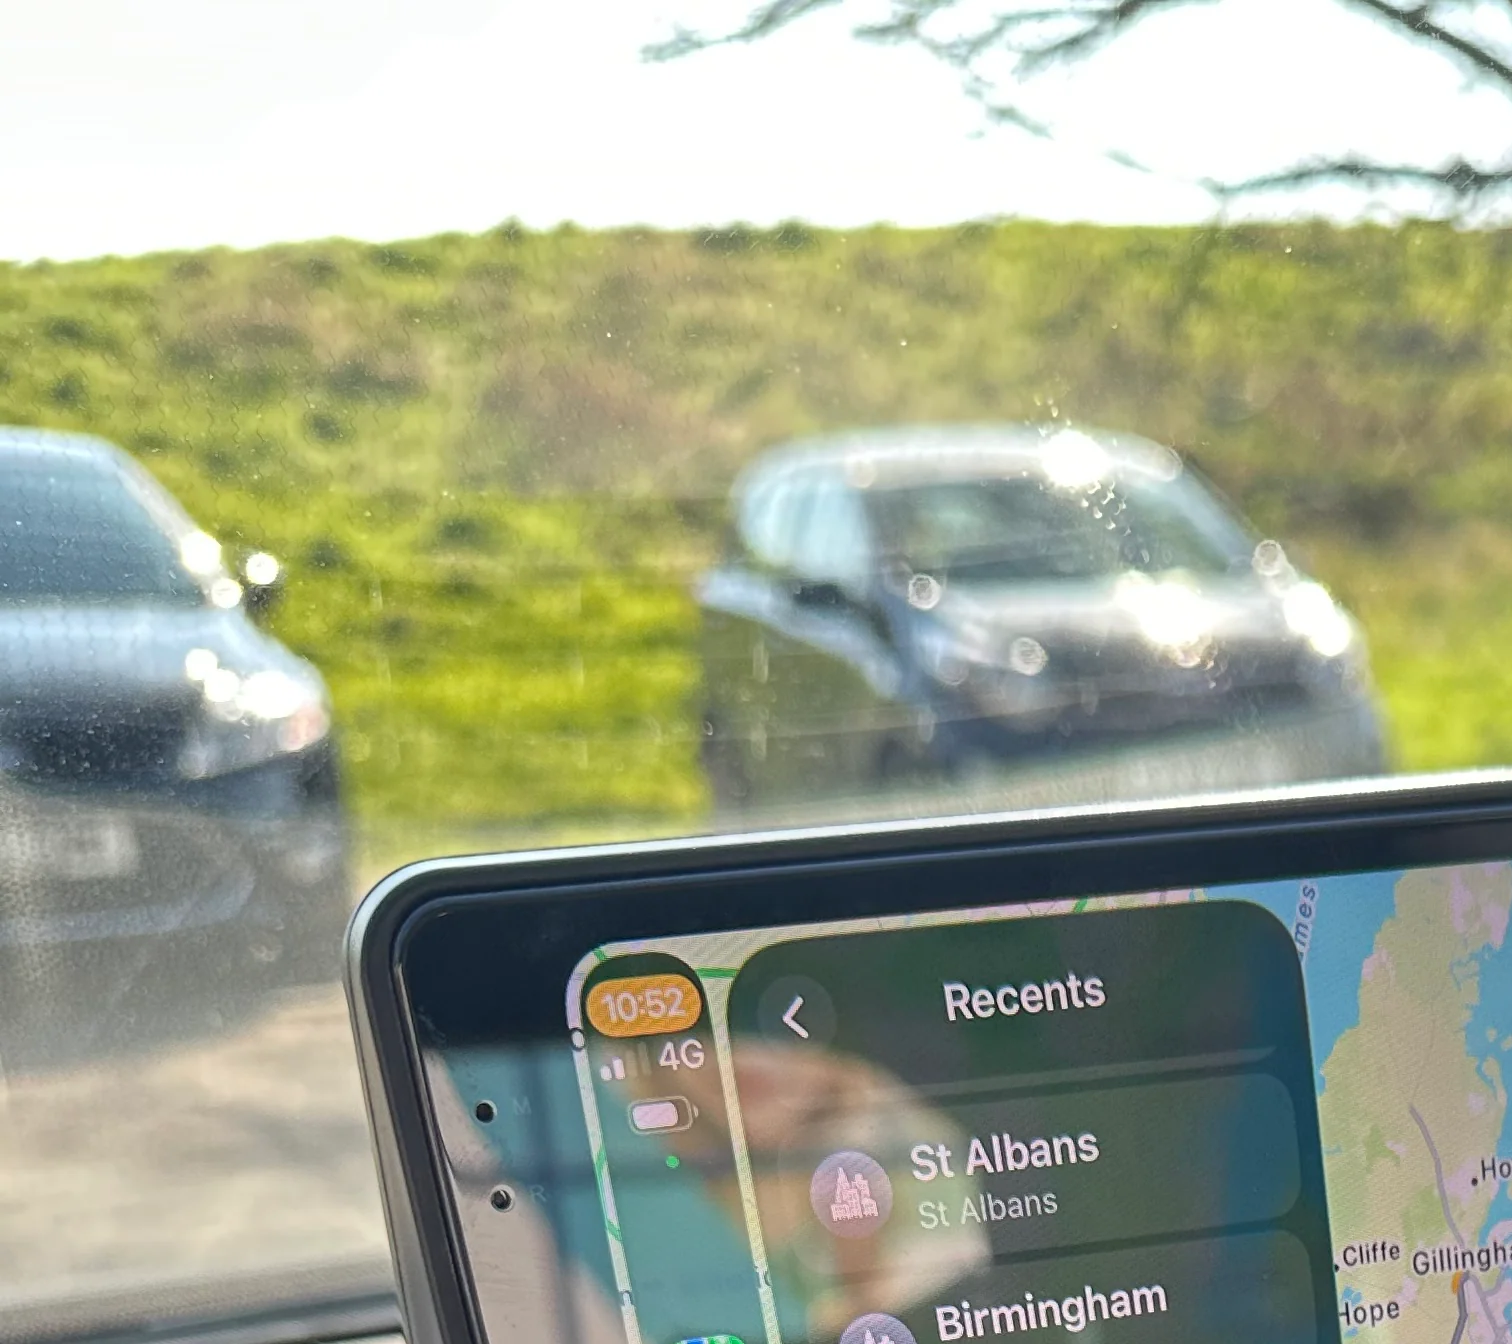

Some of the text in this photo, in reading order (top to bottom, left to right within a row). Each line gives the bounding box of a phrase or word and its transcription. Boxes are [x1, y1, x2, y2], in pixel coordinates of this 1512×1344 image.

[1295, 886, 1316, 959] mes
[601, 987, 688, 1023] 10:52
[943, 971, 1107, 1021] Recents
[659, 1039, 705, 1070] 4G
[911, 1131, 1100, 1182] St Albans
[918, 1191, 1058, 1230] St Albans
[1343, 1242, 1400, 1266] Cliffe
[935, 1283, 1168, 1342] Birmingham
